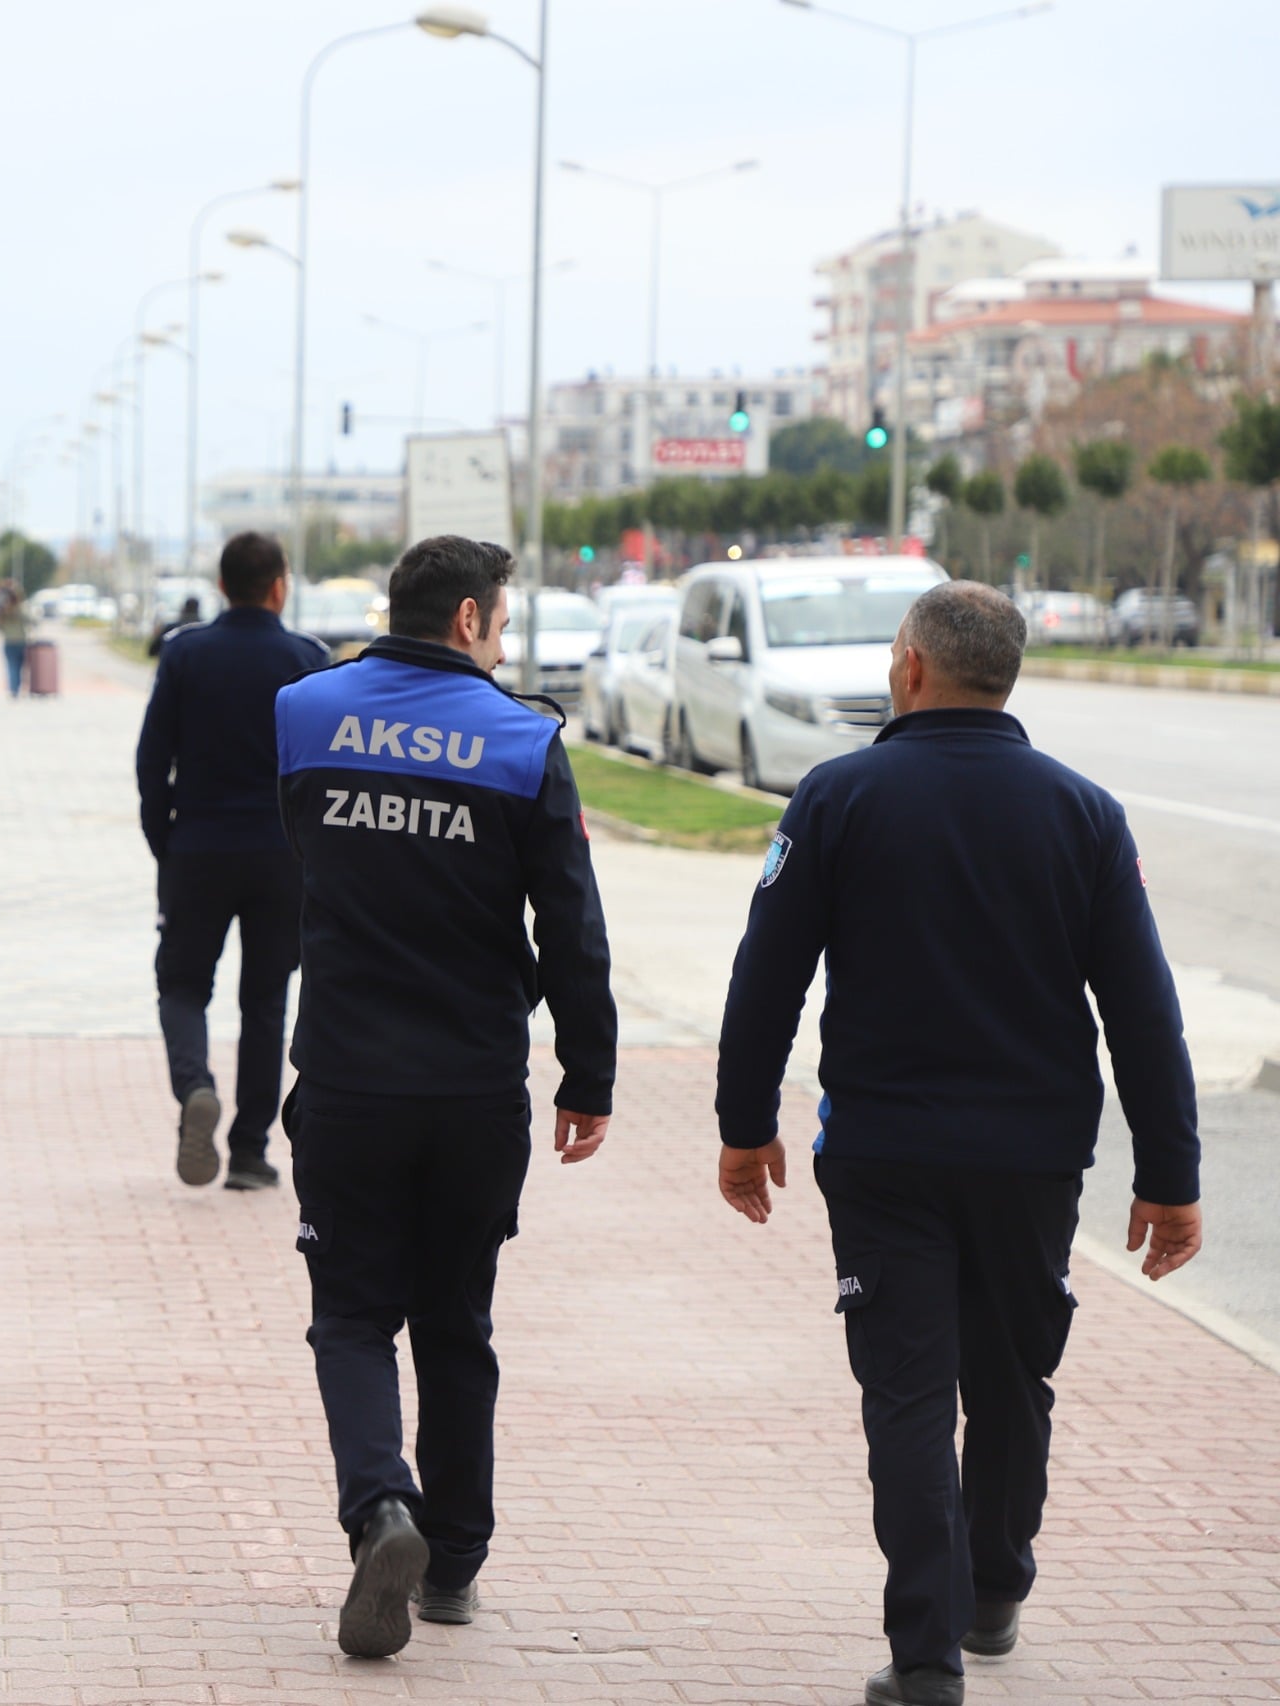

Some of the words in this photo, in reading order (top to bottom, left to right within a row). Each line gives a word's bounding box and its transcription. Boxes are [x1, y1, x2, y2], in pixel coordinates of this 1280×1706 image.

[329, 715, 485, 769] AKSU
[323, 789, 475, 842] ZABITA
[839, 1276, 863, 1296] BITA
